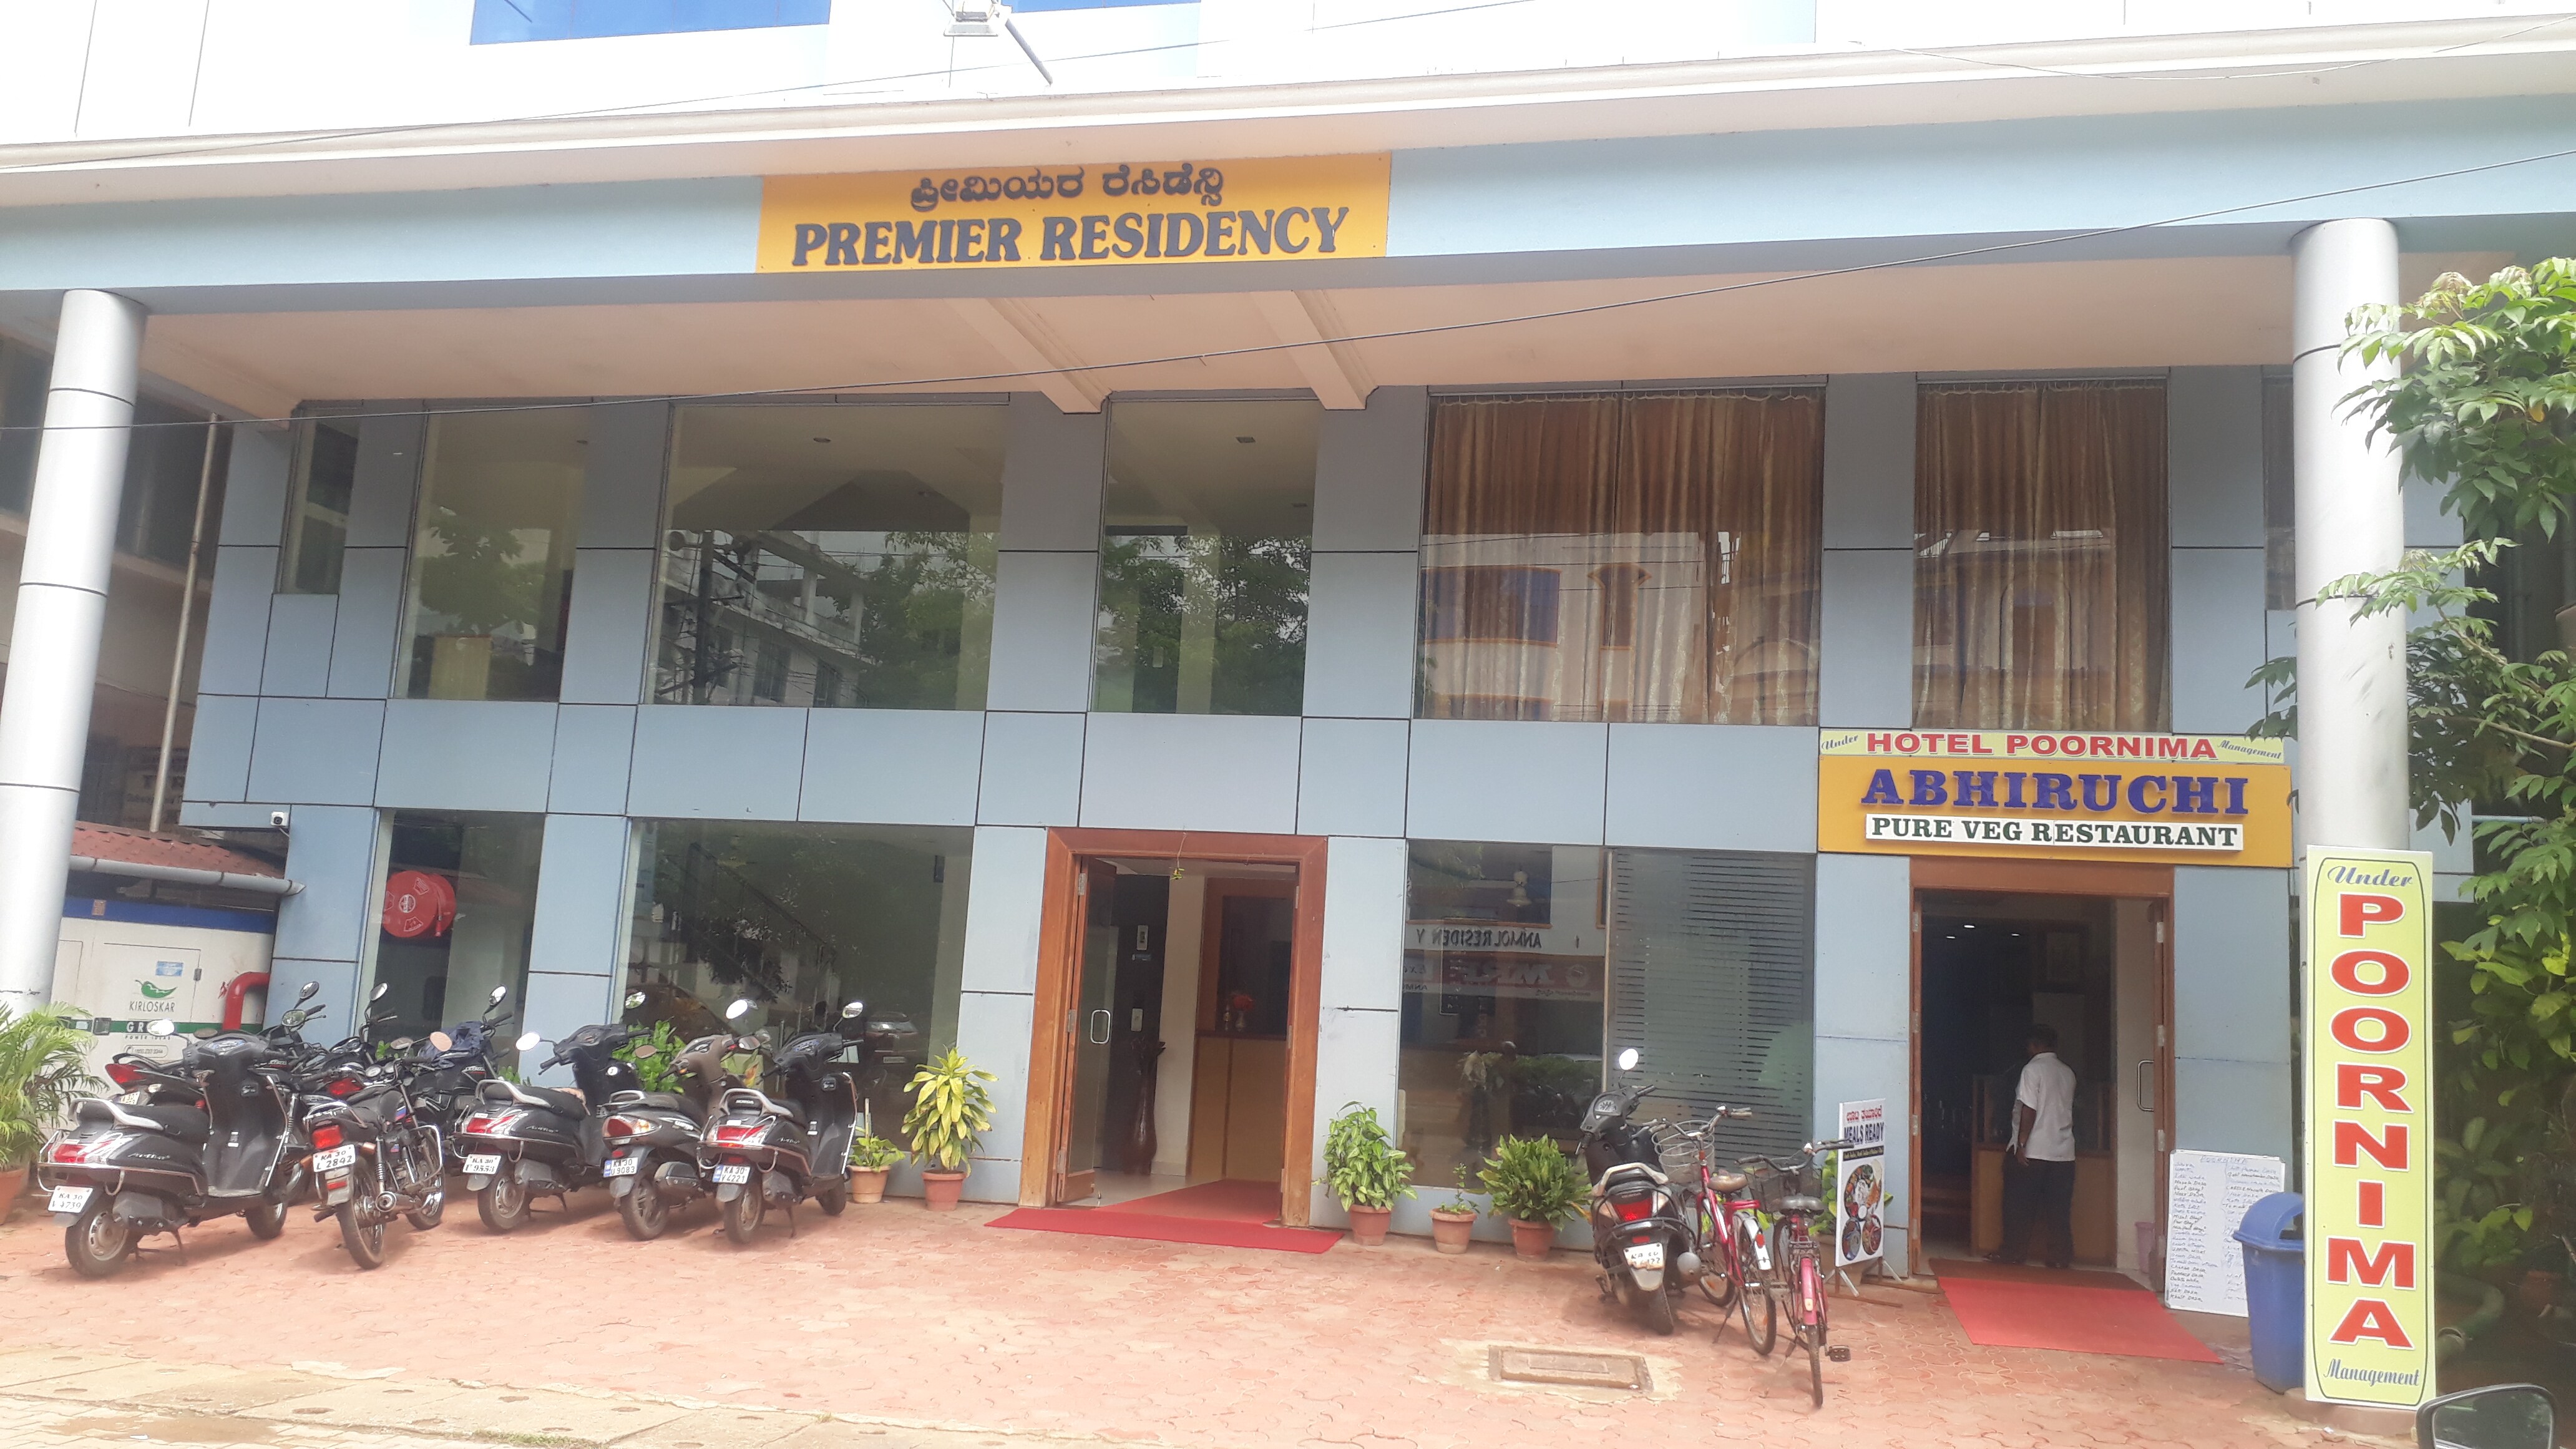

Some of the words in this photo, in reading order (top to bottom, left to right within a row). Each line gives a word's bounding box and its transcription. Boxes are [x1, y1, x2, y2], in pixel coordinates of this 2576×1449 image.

[791, 218, 1022, 266] PREMIER
[1041, 206, 1349, 260] RESIDENCY
[1822, 734, 1858, 750] Under
[1866, 733, 1993, 754] HOTEL
[2006, 734, 2218, 759] POORNIMA
[2217, 739, 2282, 759] Management
[1861, 768, 2249, 816] ABHIRUCHI
[1872, 817, 1953, 838] PURE
[1961, 821, 2022, 841] VEG
[2031, 822, 2238, 847] RESTAURANT
[2328, 866, 2413, 887] Under
[129, 1001, 175, 1012] KIRLOSKAR
[1844, 1125, 1863, 1144] MEALS
[1865, 1122, 1885, 1144] READY
[2328, 892, 2416, 1350] POORNIMA
[726, 1174, 745, 1183] 4221
[2323, 1358, 2420, 1387] Management
